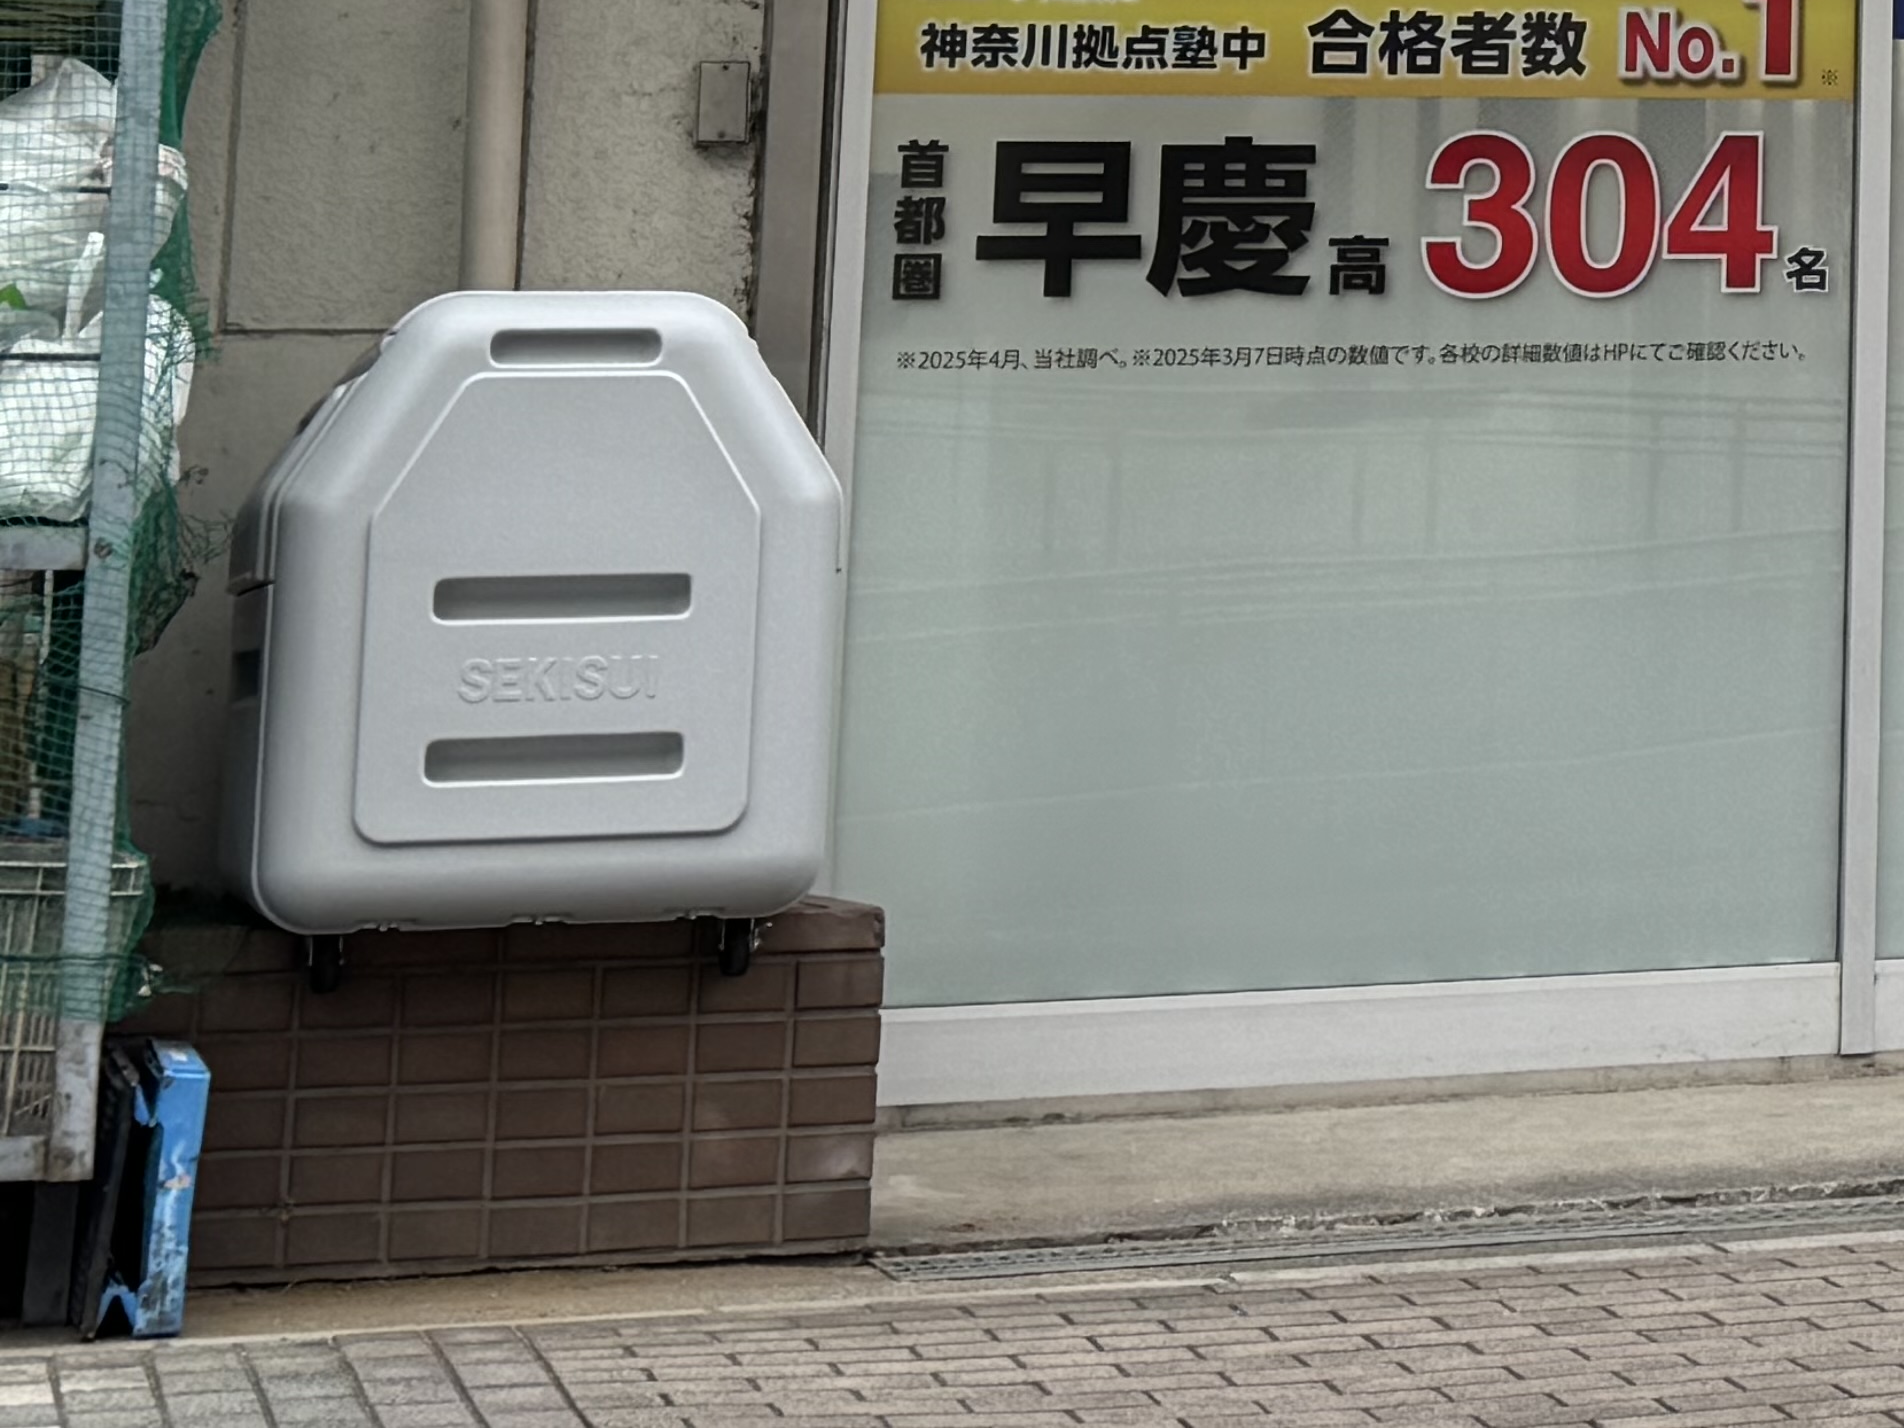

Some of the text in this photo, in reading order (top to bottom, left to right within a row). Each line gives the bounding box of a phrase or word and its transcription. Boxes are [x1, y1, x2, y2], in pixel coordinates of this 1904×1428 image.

[919, 21, 1268, 73] 神奈川拠点塾中
[1306, 8, 1589, 80] 合格者数
[892, 139, 950, 302] 首都圏
[974, 136, 1391, 300] 早慶高
[456, 654, 660, 704] SEKISUI
